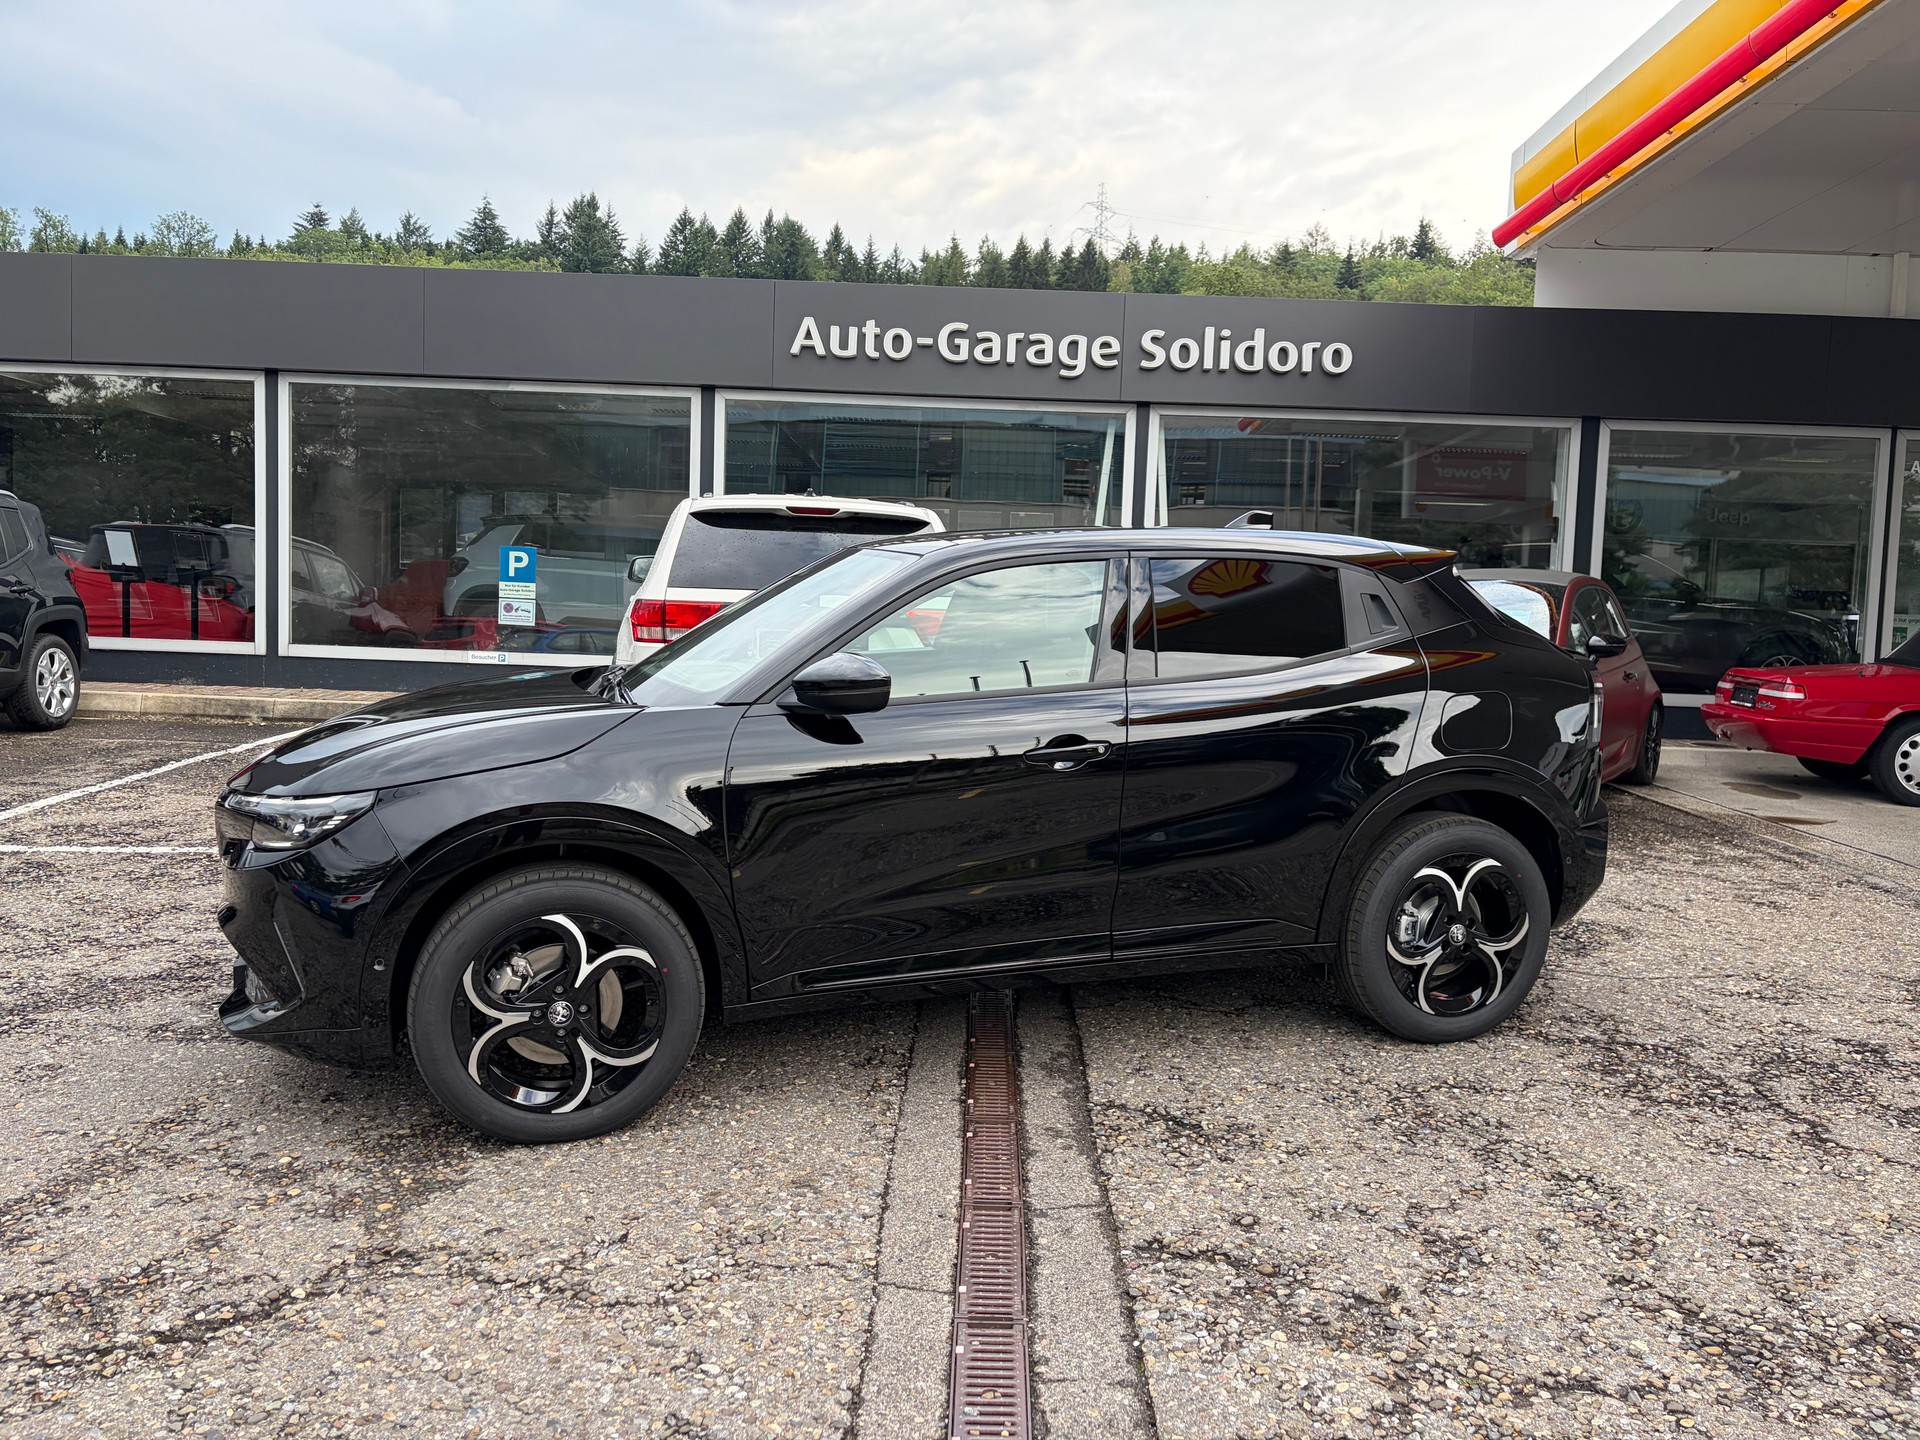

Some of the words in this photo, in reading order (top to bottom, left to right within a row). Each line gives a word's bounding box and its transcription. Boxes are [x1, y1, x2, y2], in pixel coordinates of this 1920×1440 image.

[790, 316, 1121, 379] Auto-Garage
[1139, 326, 1354, 376] Solidoro
[1706, 507, 1750, 527] Jeep
[508, 551, 530, 577] P
